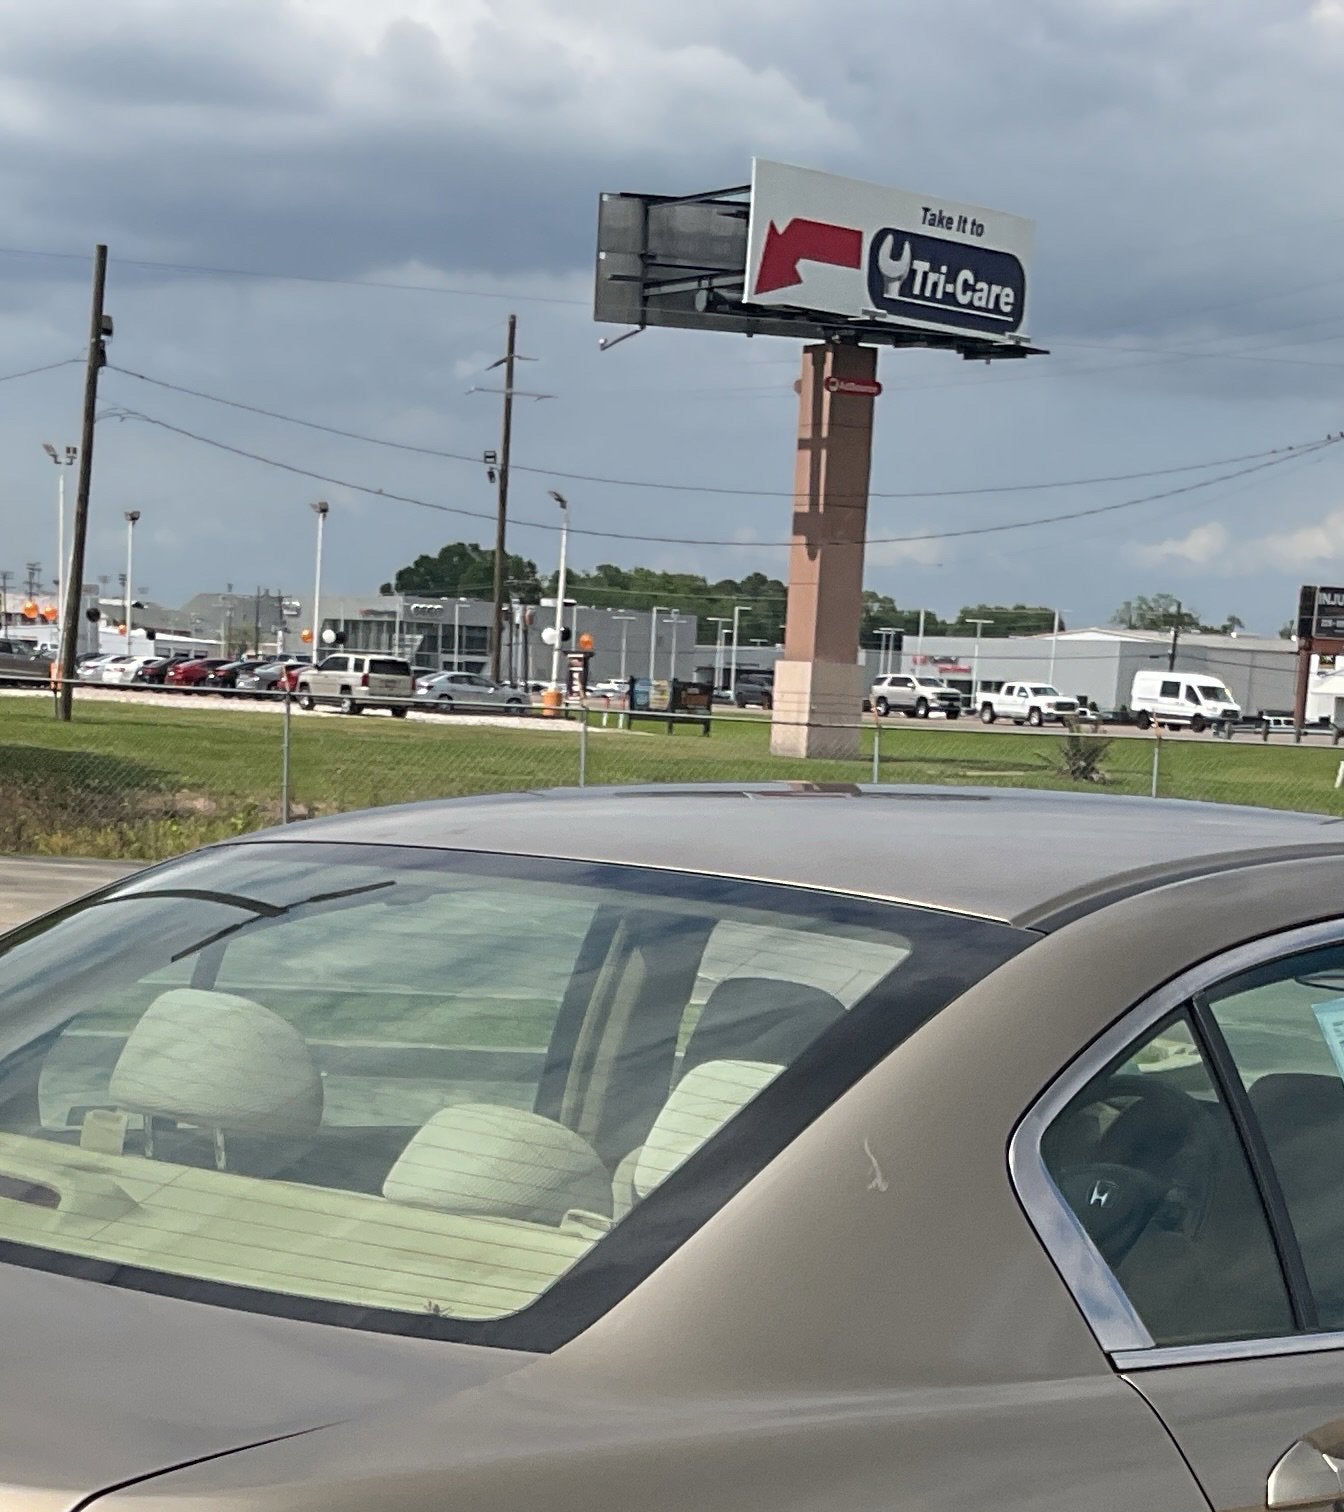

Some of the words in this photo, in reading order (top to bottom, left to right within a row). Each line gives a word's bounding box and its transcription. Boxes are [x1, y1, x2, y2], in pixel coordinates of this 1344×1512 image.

[921, 206, 954, 231] Take
[970, 218, 985, 238] to
[911, 259, 1015, 313] Tri-Care
